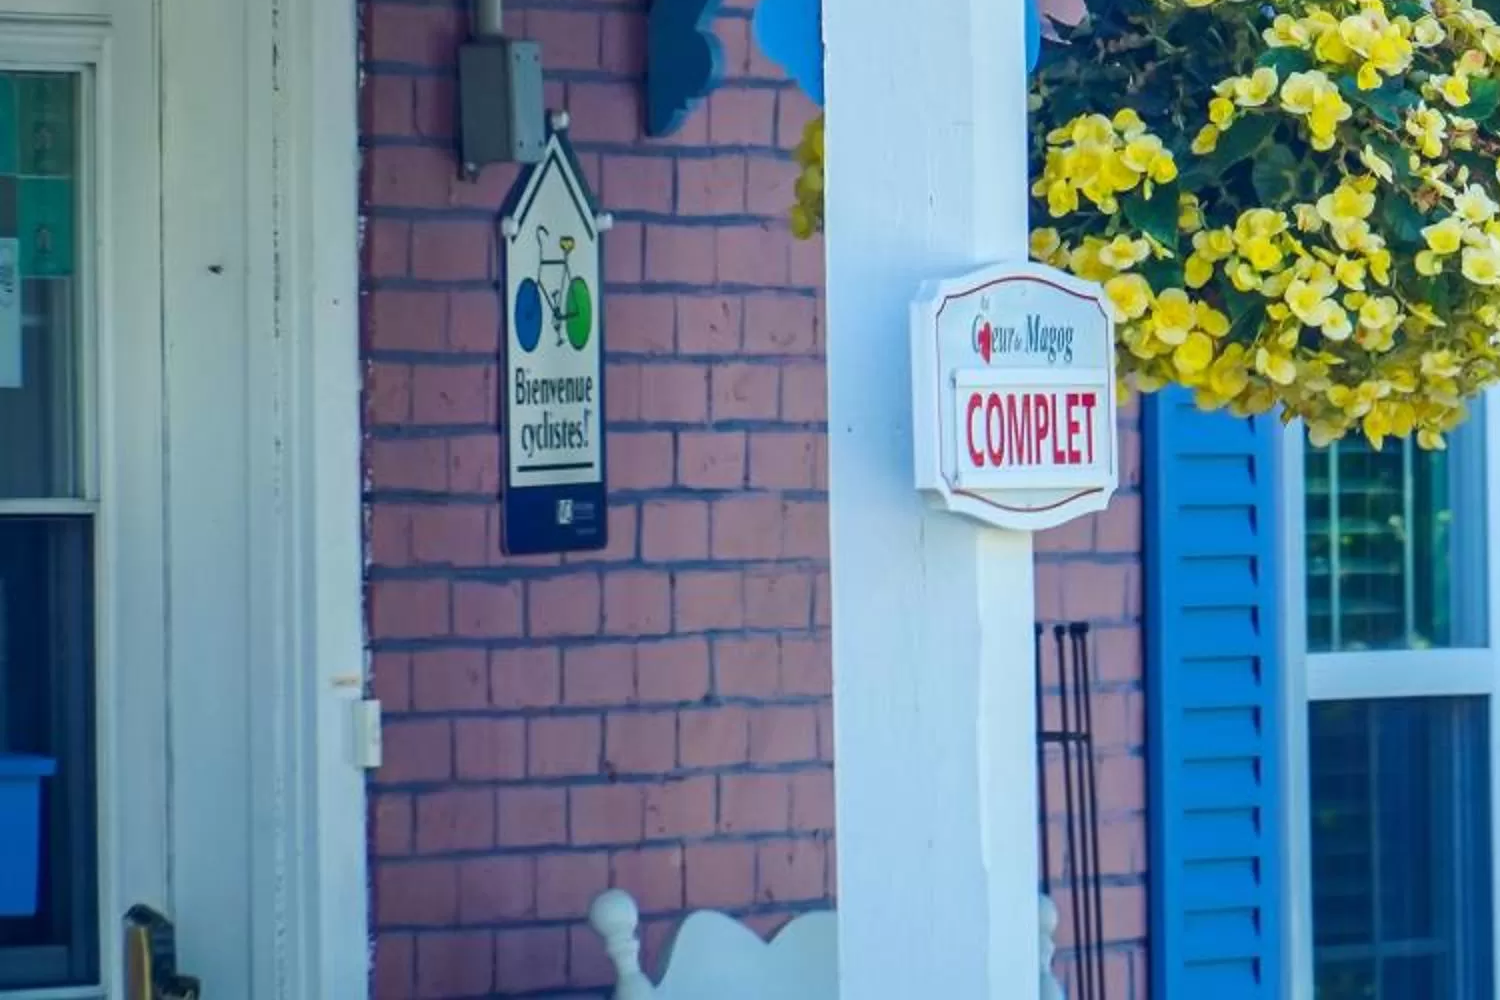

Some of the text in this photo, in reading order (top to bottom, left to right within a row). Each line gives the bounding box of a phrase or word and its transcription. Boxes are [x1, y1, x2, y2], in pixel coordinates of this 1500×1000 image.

[972, 314, 1014, 363] Ceur
[1023, 314, 1074, 363] Magog
[515, 366, 593, 405] Bienvenue
[521, 408, 592, 458] cyclistes!
[966, 391, 1097, 468] COMPLET
